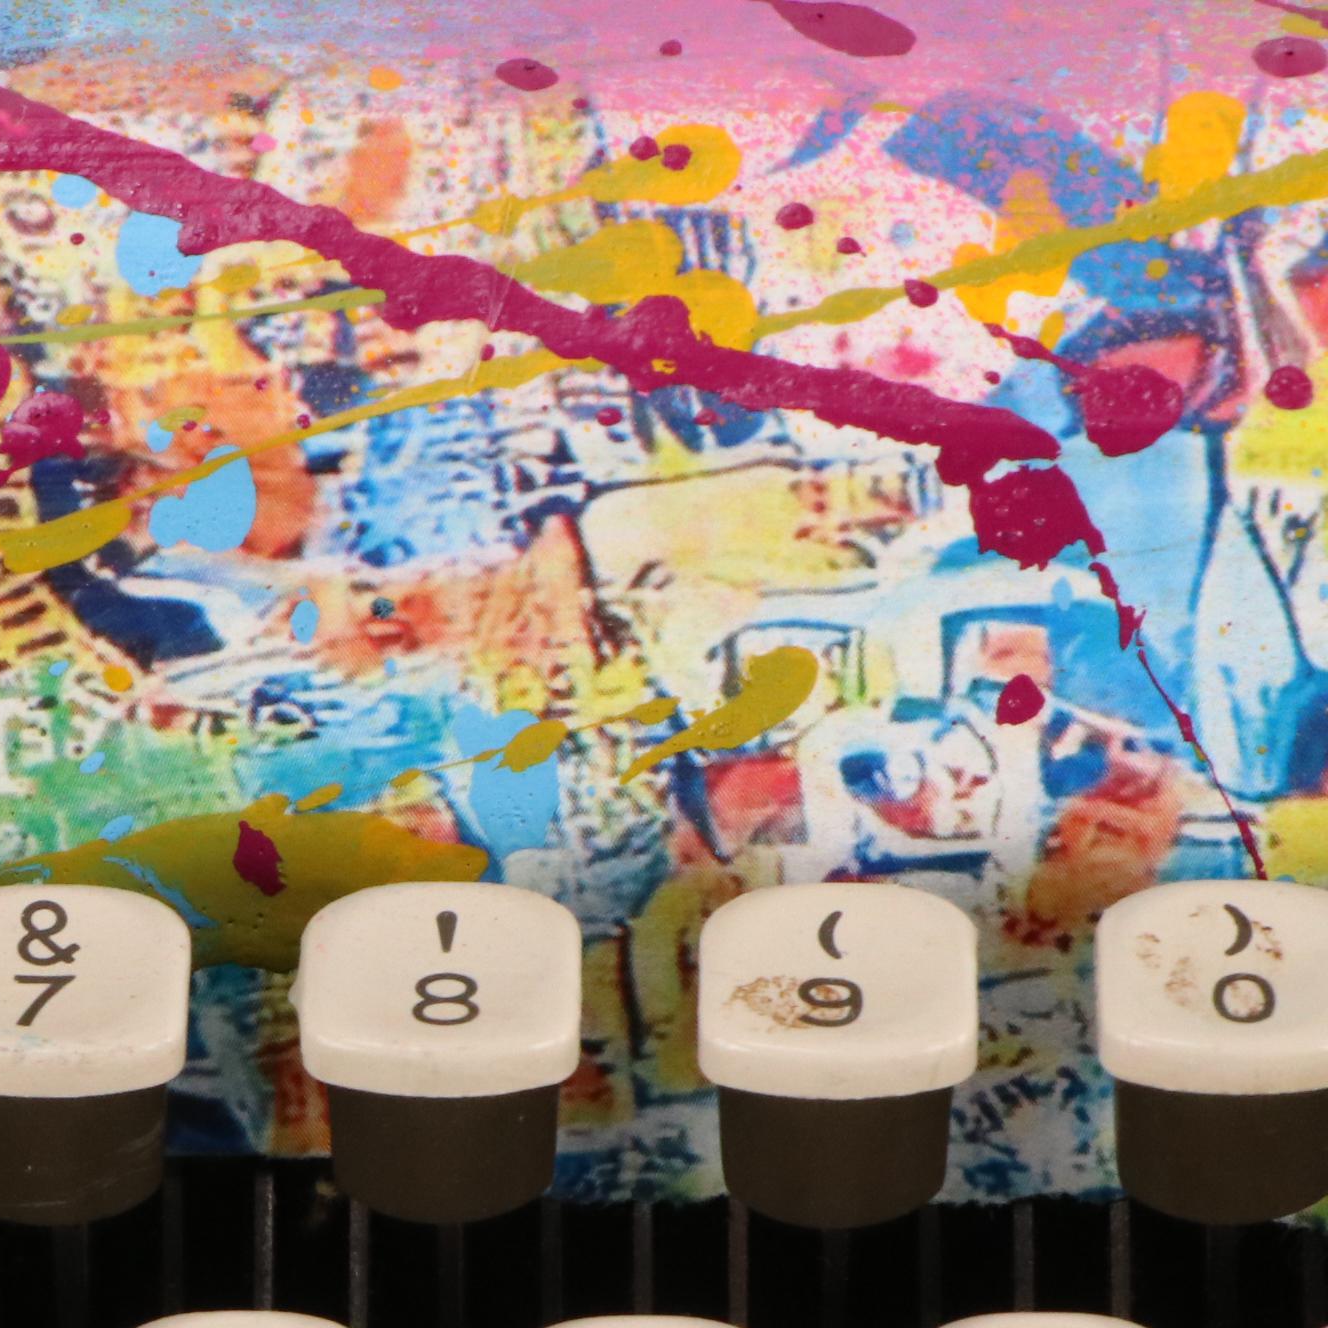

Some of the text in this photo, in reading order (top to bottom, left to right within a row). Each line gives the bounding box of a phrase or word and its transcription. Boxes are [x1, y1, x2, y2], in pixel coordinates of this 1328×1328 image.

[17, 900, 81, 967] &
[817, 911, 842, 960] (
[1223, 903, 1253, 957] )
[13, 974, 76, 1027] 7
[411, 972, 480, 1026] 8
[796, 977, 863, 1028] 9
[1212, 972, 1276, 1024] 0
